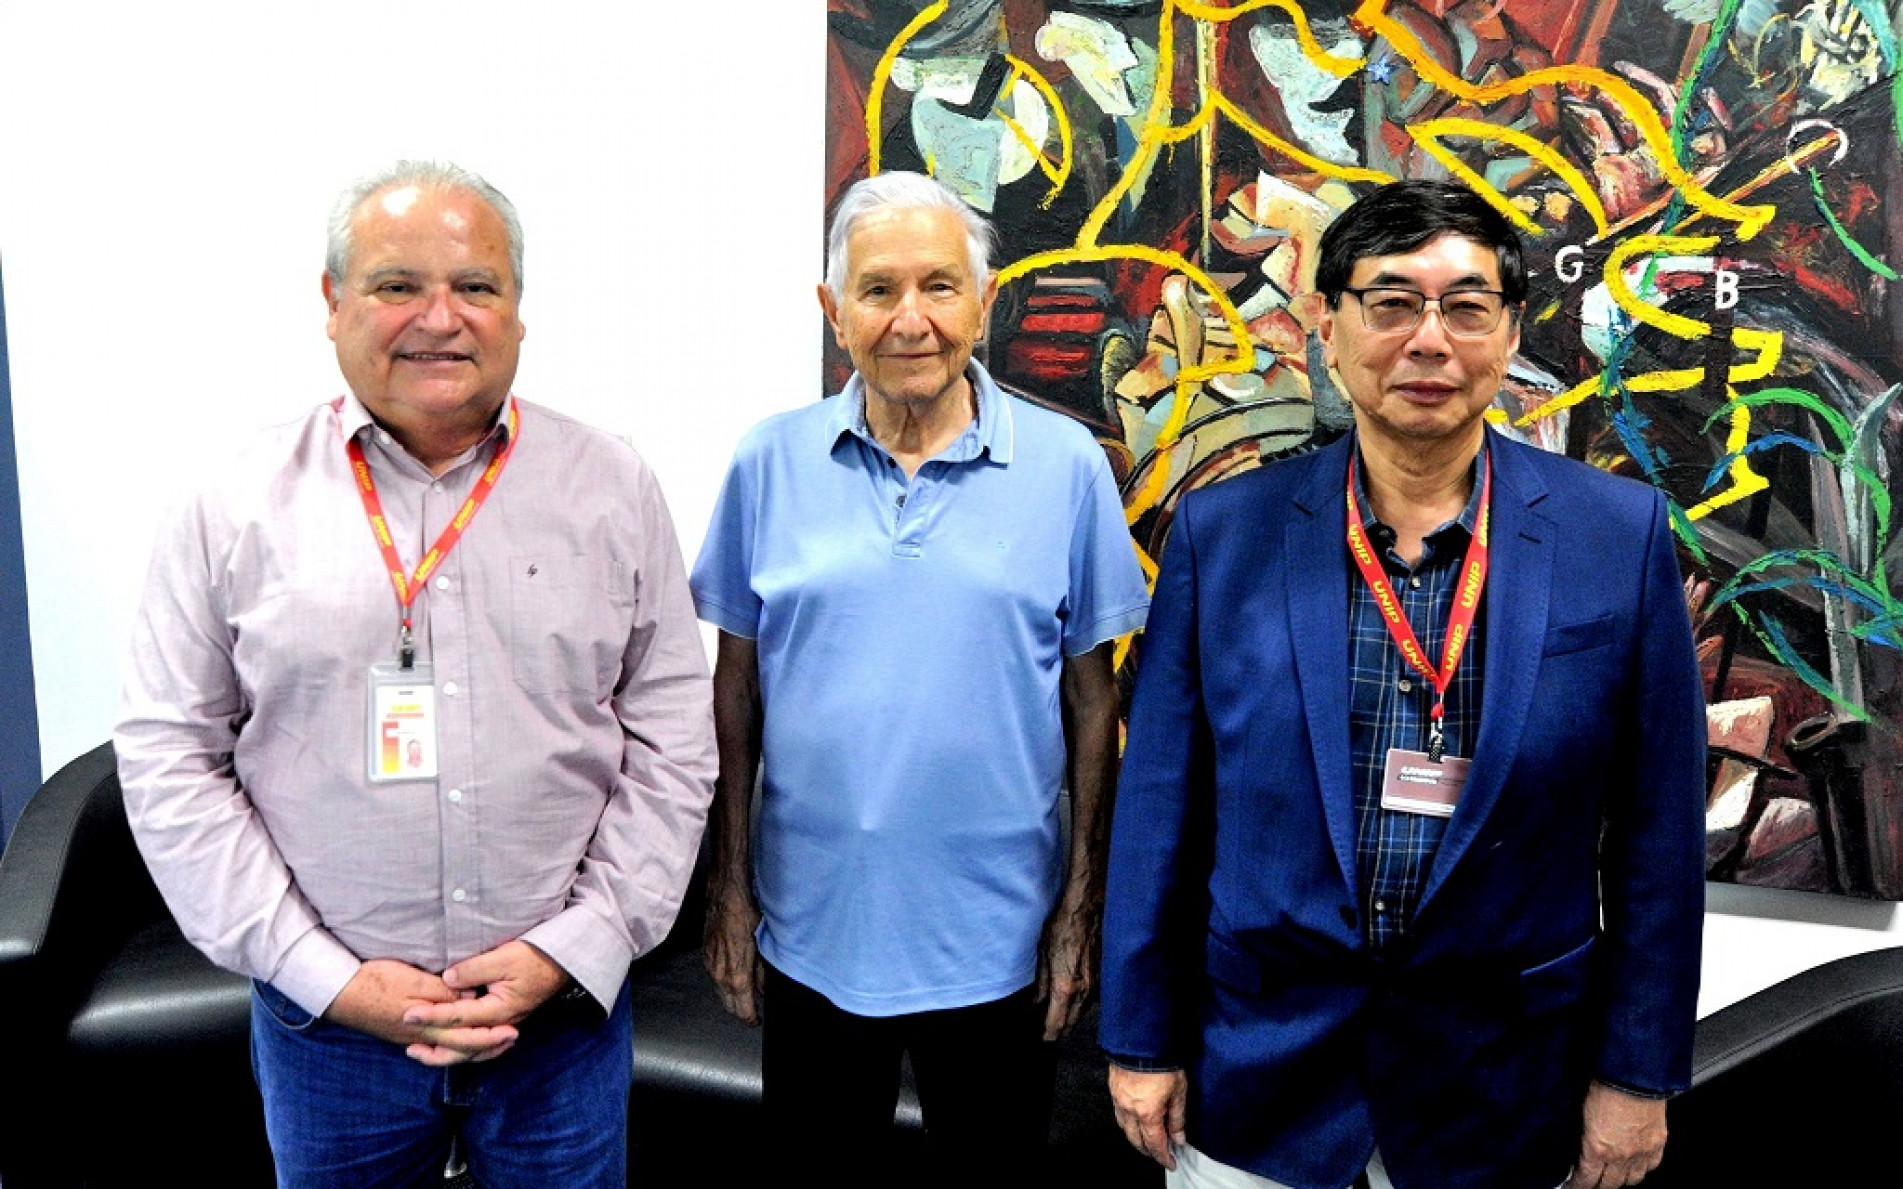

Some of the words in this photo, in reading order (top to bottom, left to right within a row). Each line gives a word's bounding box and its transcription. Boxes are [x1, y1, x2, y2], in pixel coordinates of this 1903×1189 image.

[1715, 267, 1739, 310] B
[1348, 523, 1372, 566] UNIP
[1372, 580, 1400, 624] UNIP
[1460, 560, 1481, 609] UNIP
[1445, 623, 1464, 670] UNIP
